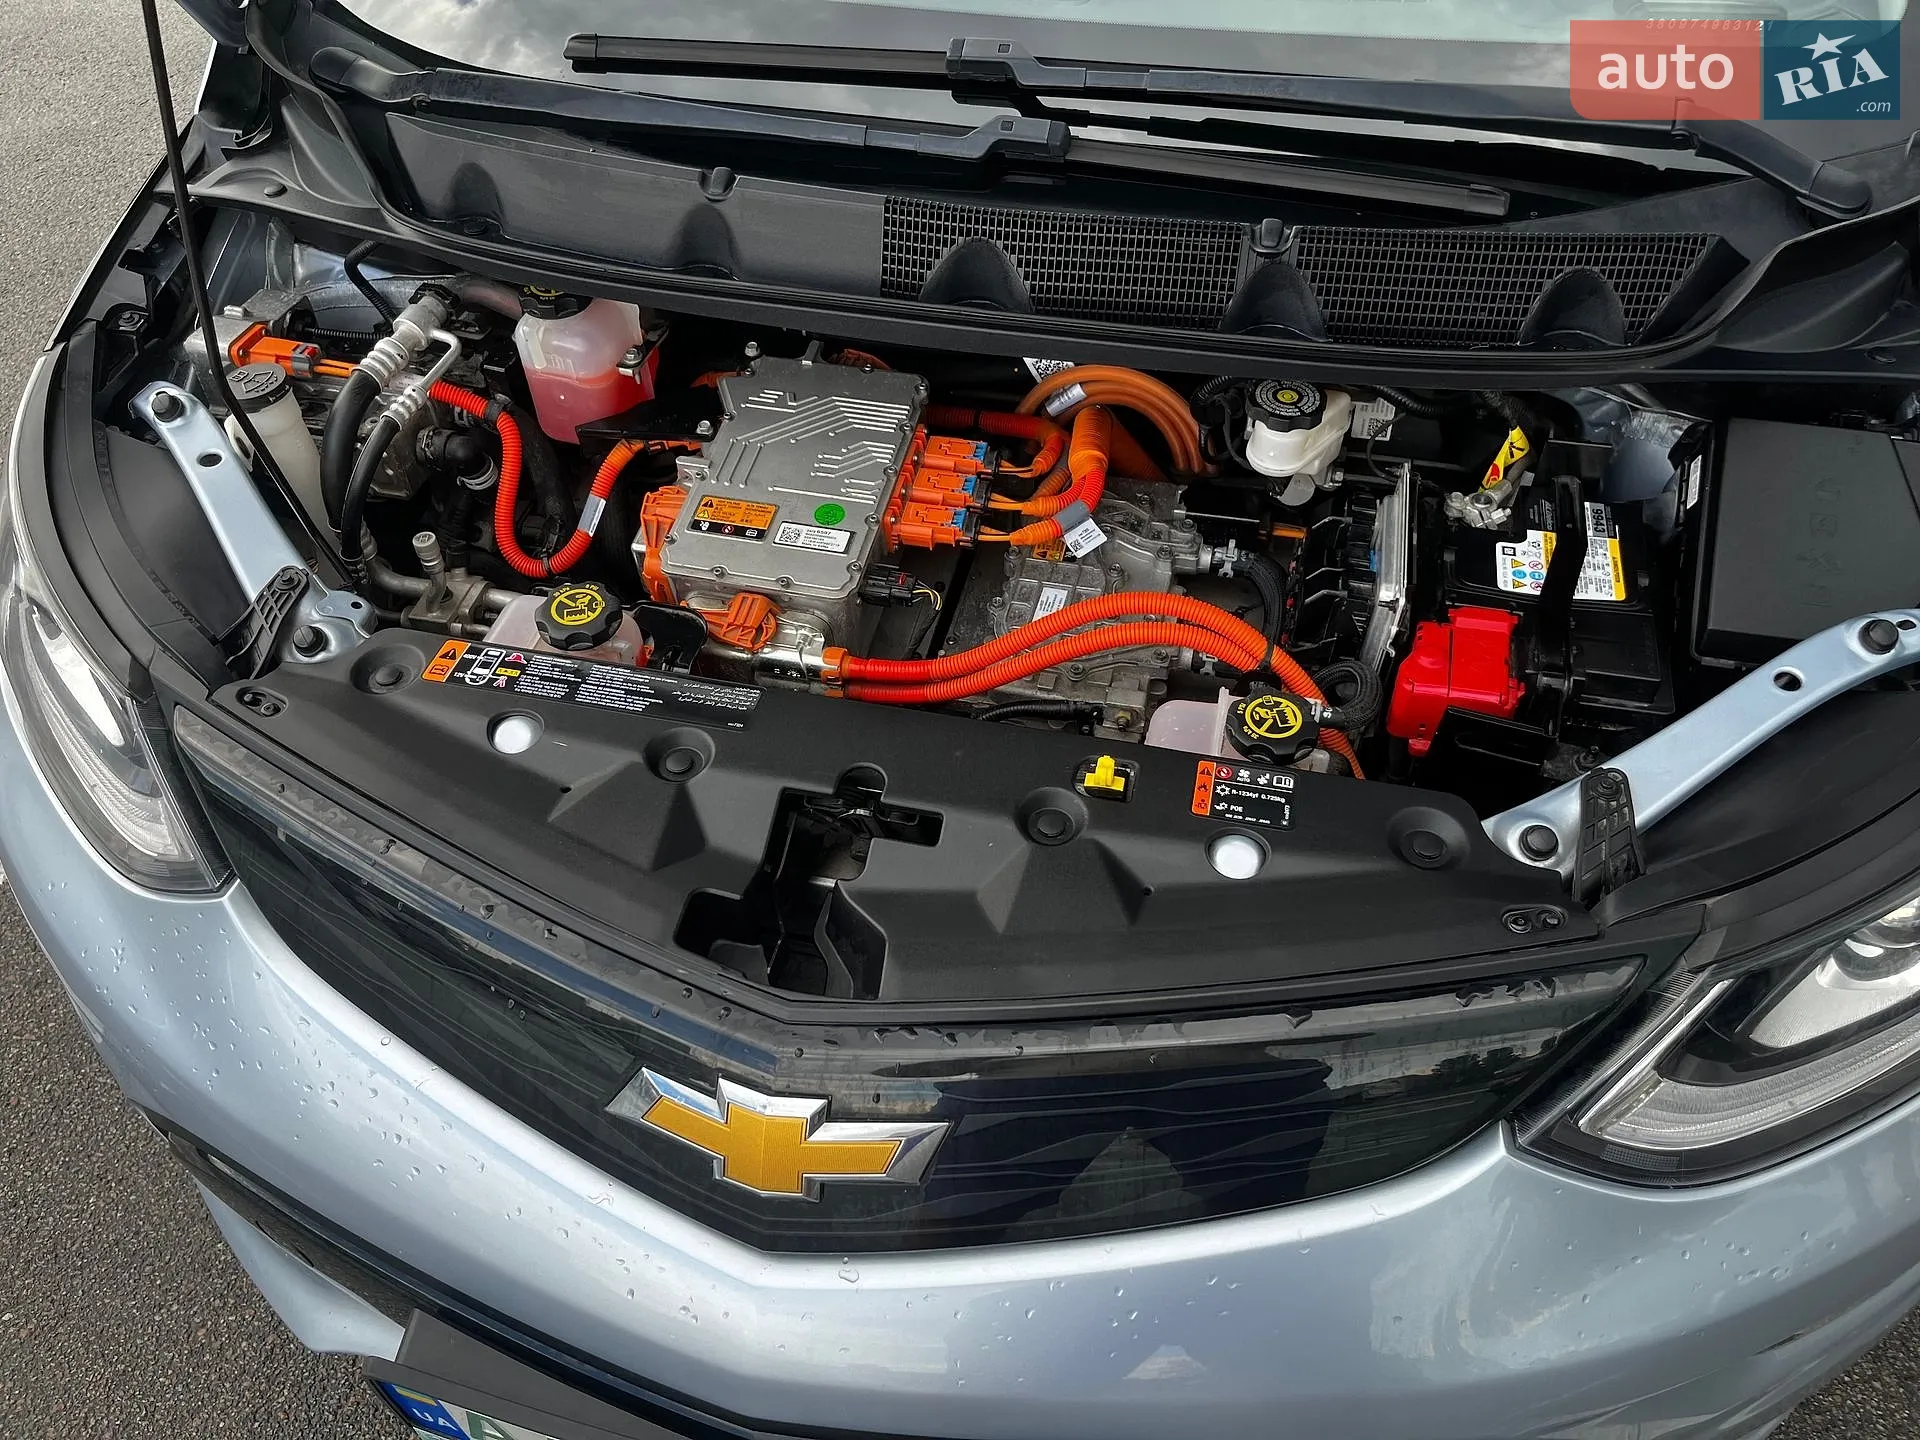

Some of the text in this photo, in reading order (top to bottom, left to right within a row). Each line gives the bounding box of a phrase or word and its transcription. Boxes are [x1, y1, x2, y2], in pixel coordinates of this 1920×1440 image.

[1593, 508, 1606, 532] 9943
[1230, 805, 1243, 813] POE
[411, 1407, 459, 1431] UA
